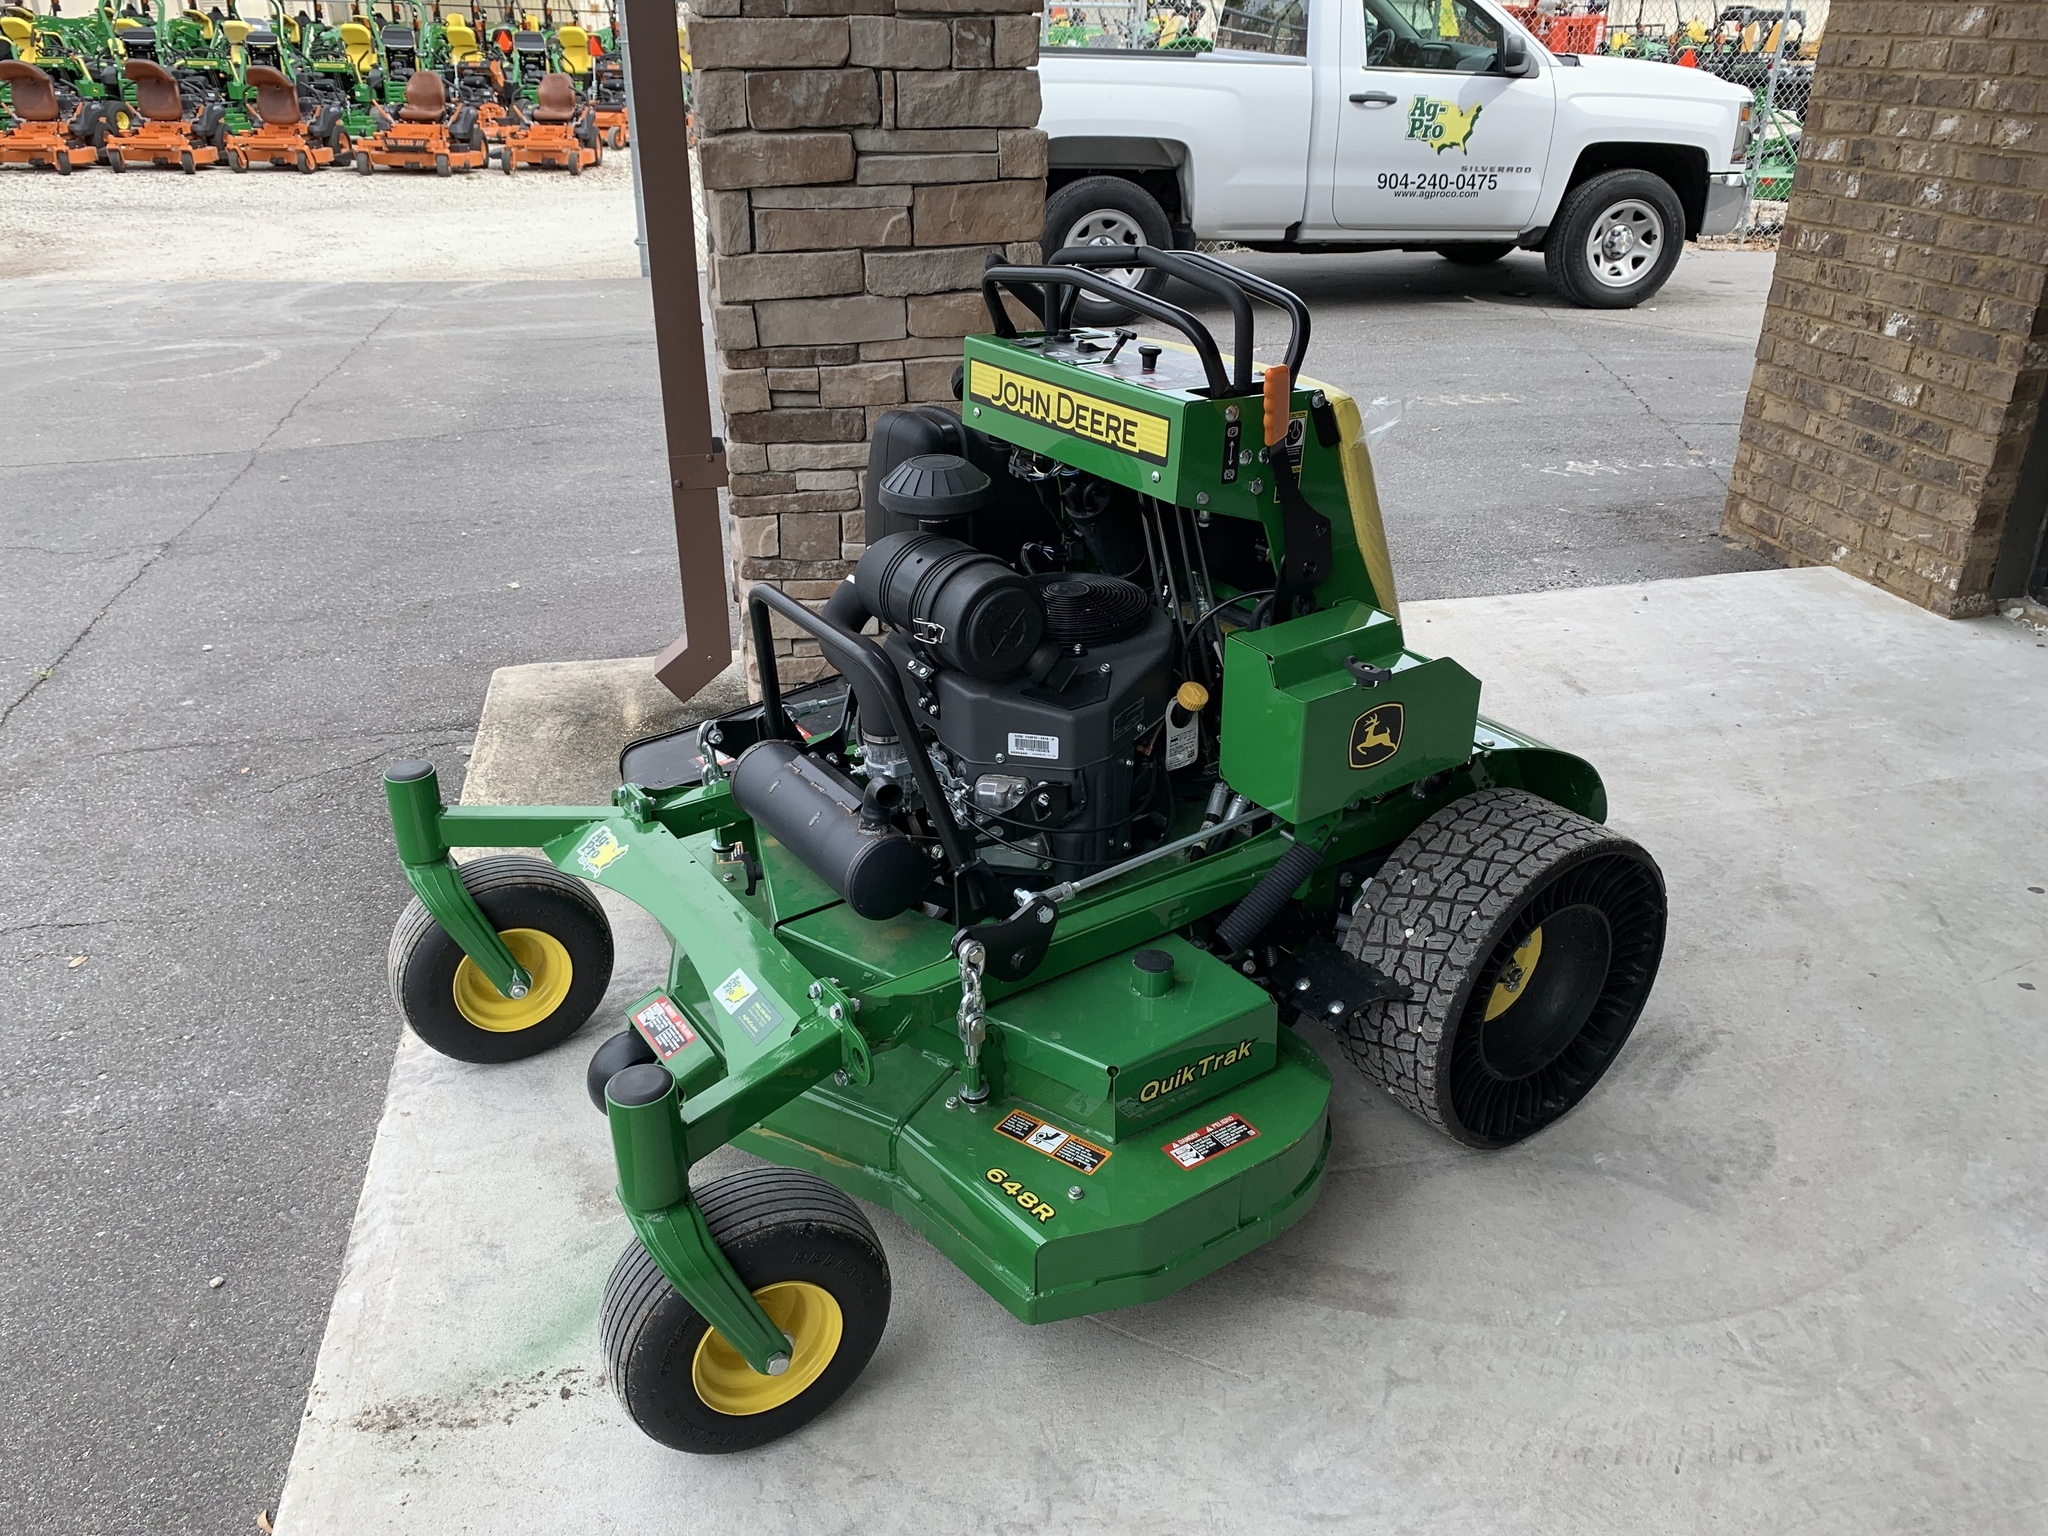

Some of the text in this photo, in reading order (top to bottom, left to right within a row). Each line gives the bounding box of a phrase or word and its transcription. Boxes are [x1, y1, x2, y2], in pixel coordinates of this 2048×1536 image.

[1409, 96, 1447, 122] Ag-
[1407, 117, 1444, 139] Pro
[1461, 165, 1533, 173] SILVERADO
[1377, 172, 1498, 190] 904-240-0475
[1393, 190, 1479, 199] www.agproco.com
[991, 373, 1139, 448] JOHN DEERE
[580, 841, 600, 858] Pro
[1178, 1132, 1201, 1145] DANGER
[1211, 1115, 1234, 1129] PELIGRO
[985, 1167, 1056, 1224] 648R
